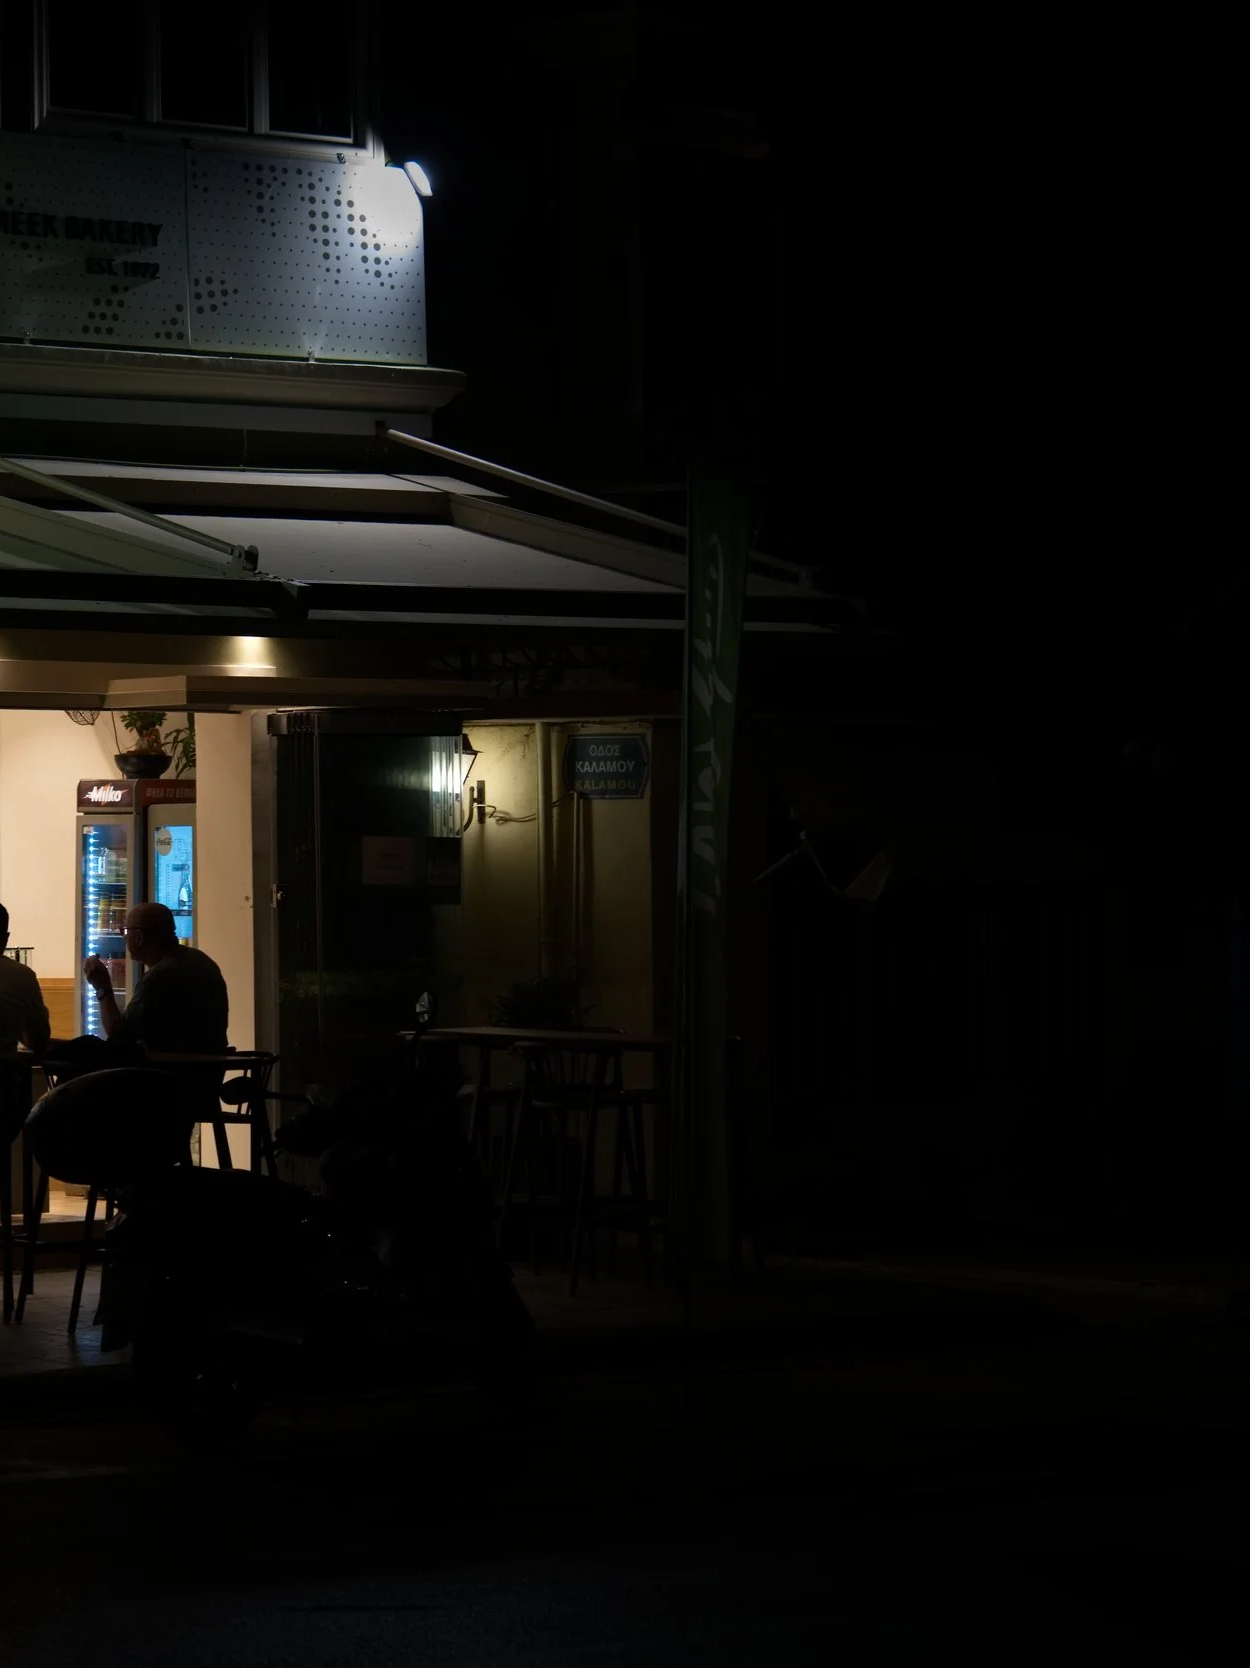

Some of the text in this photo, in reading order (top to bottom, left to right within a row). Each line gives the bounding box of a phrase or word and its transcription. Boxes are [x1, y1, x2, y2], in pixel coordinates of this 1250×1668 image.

[64, 216, 163, 247] BAKERY
[588, 744, 622, 757] ΟΔΟΣ
[574, 760, 636, 774] ΚΑΛΑΜΟΥ
[575, 779, 636, 790] KALAMOU
[90, 785, 123, 802] Milko
